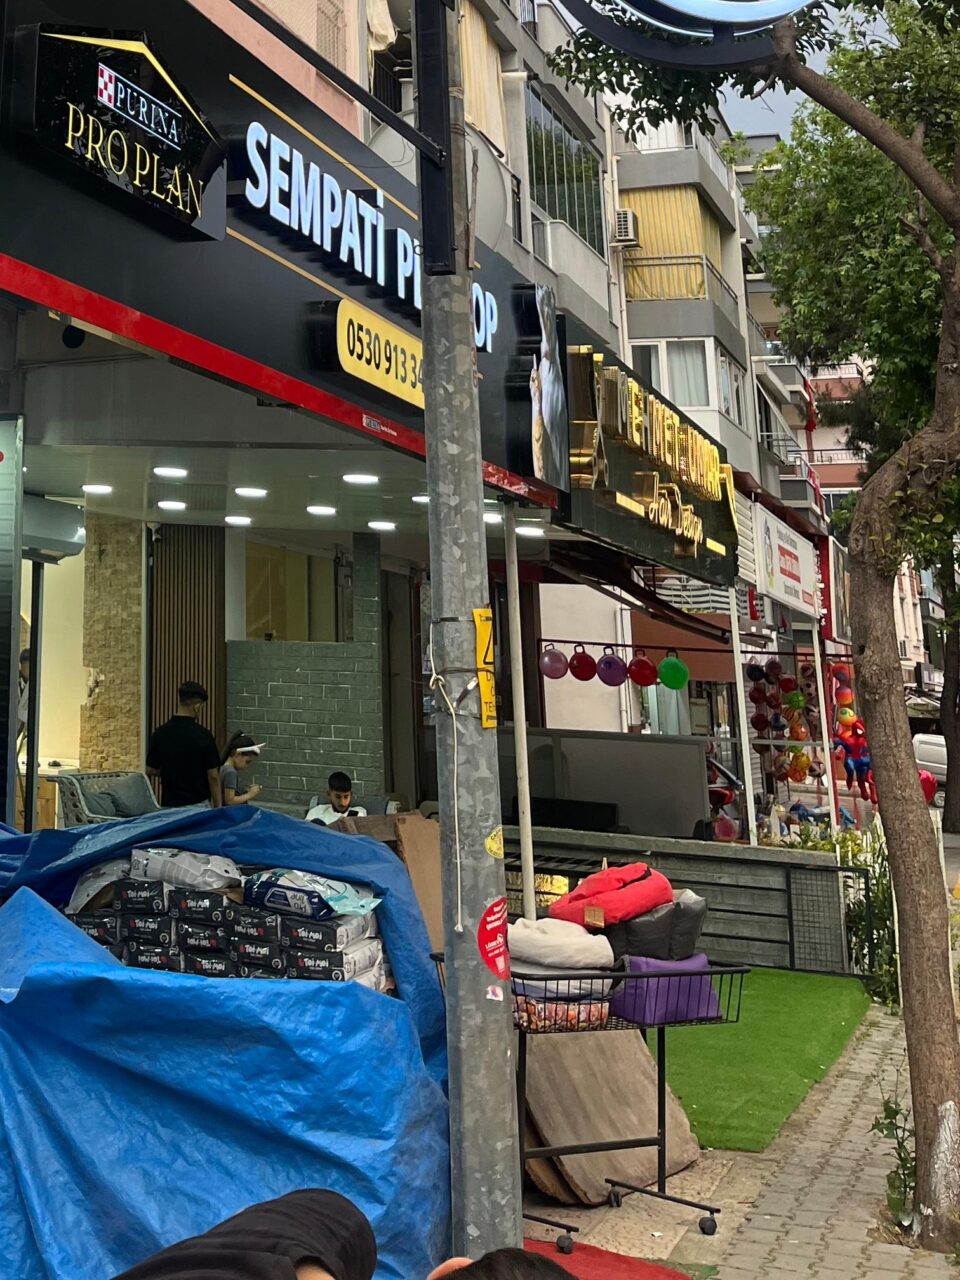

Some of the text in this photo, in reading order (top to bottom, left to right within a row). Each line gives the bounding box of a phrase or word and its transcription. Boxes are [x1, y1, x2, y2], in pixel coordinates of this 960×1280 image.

[116, 81, 179, 143] PURINA
[65, 101, 203, 219] PRO PLAN
[245, 121, 386, 287] SEMPATİ
[347, 318, 381, 370] 0530
[384, 339, 407, 384] 913
